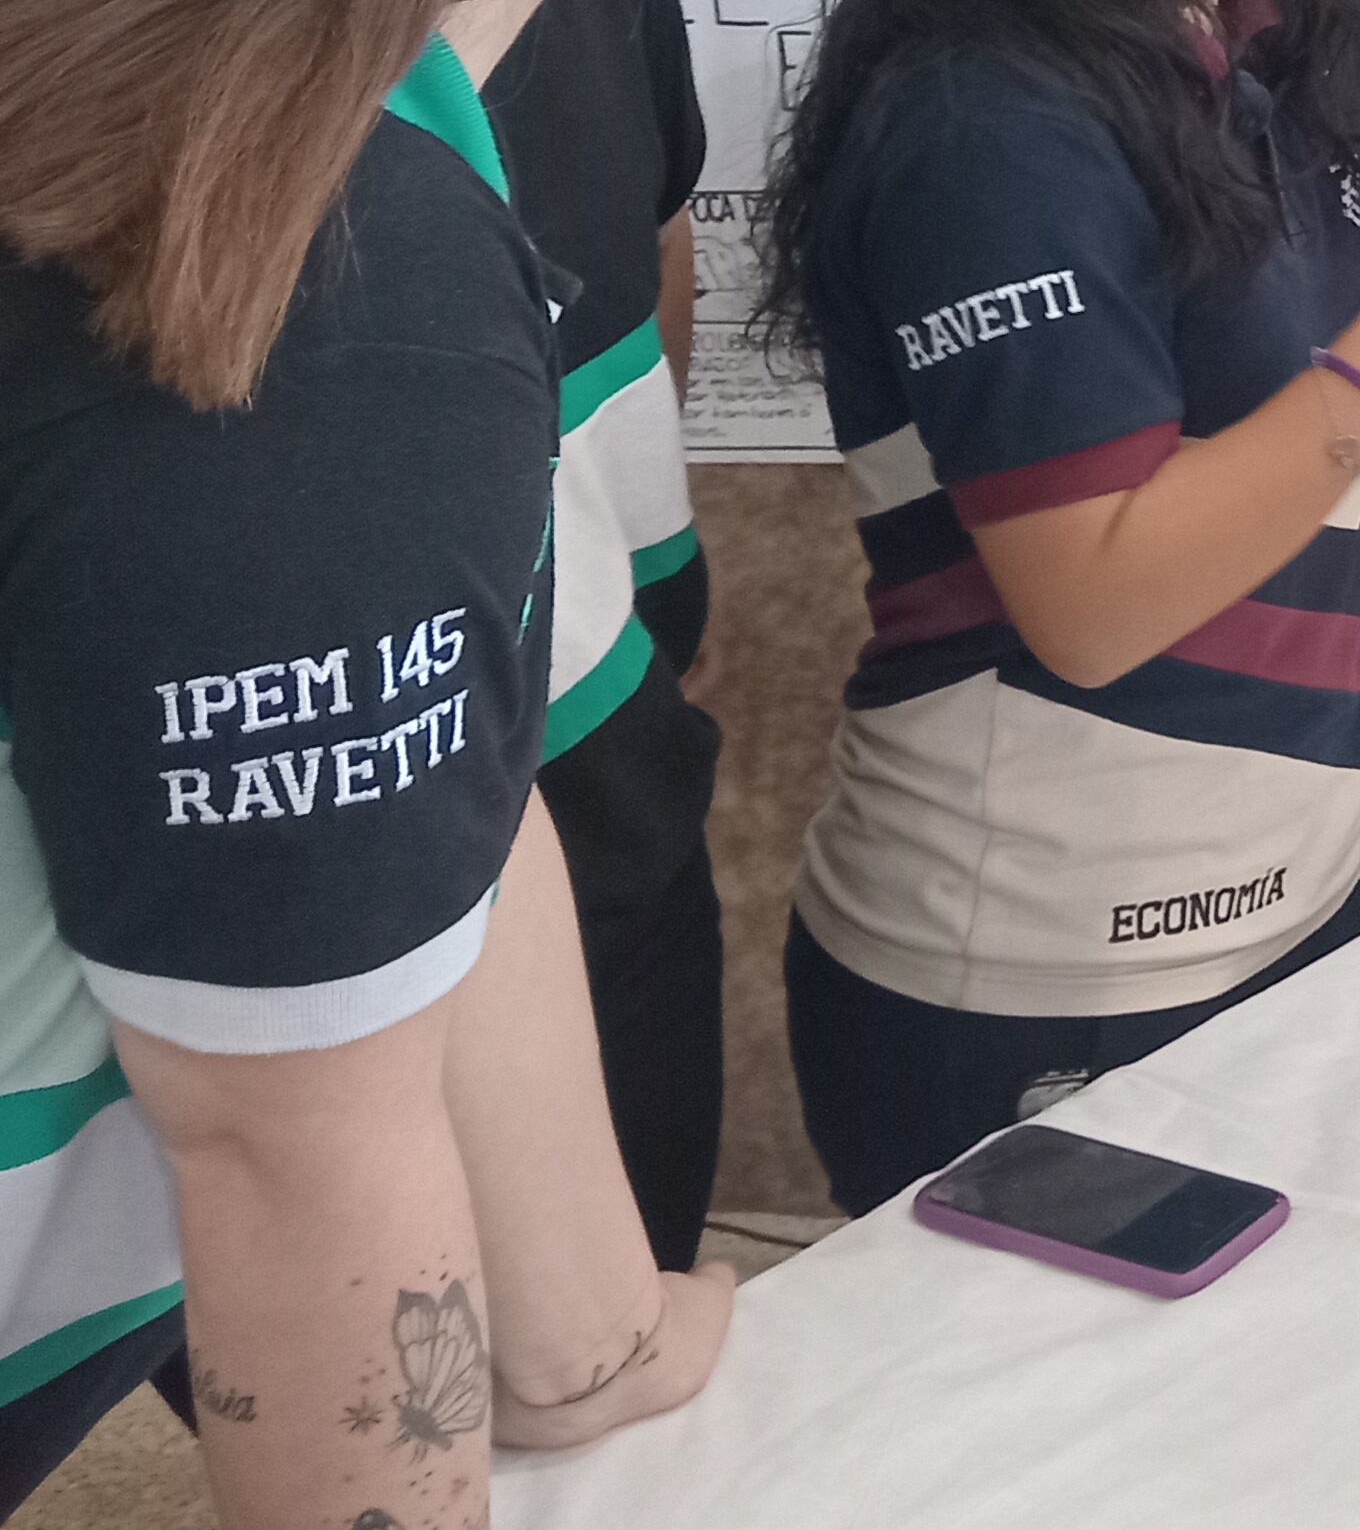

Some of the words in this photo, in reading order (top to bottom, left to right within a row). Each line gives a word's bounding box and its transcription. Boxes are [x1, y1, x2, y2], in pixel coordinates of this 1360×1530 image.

[894, 269, 1086, 371] RAVETTI
[154, 646, 353, 744] IPEM
[375, 606, 467, 703] 145
[159, 688, 470, 826] RAVETTI
[1108, 866, 1288, 944] ECONOMÍA
